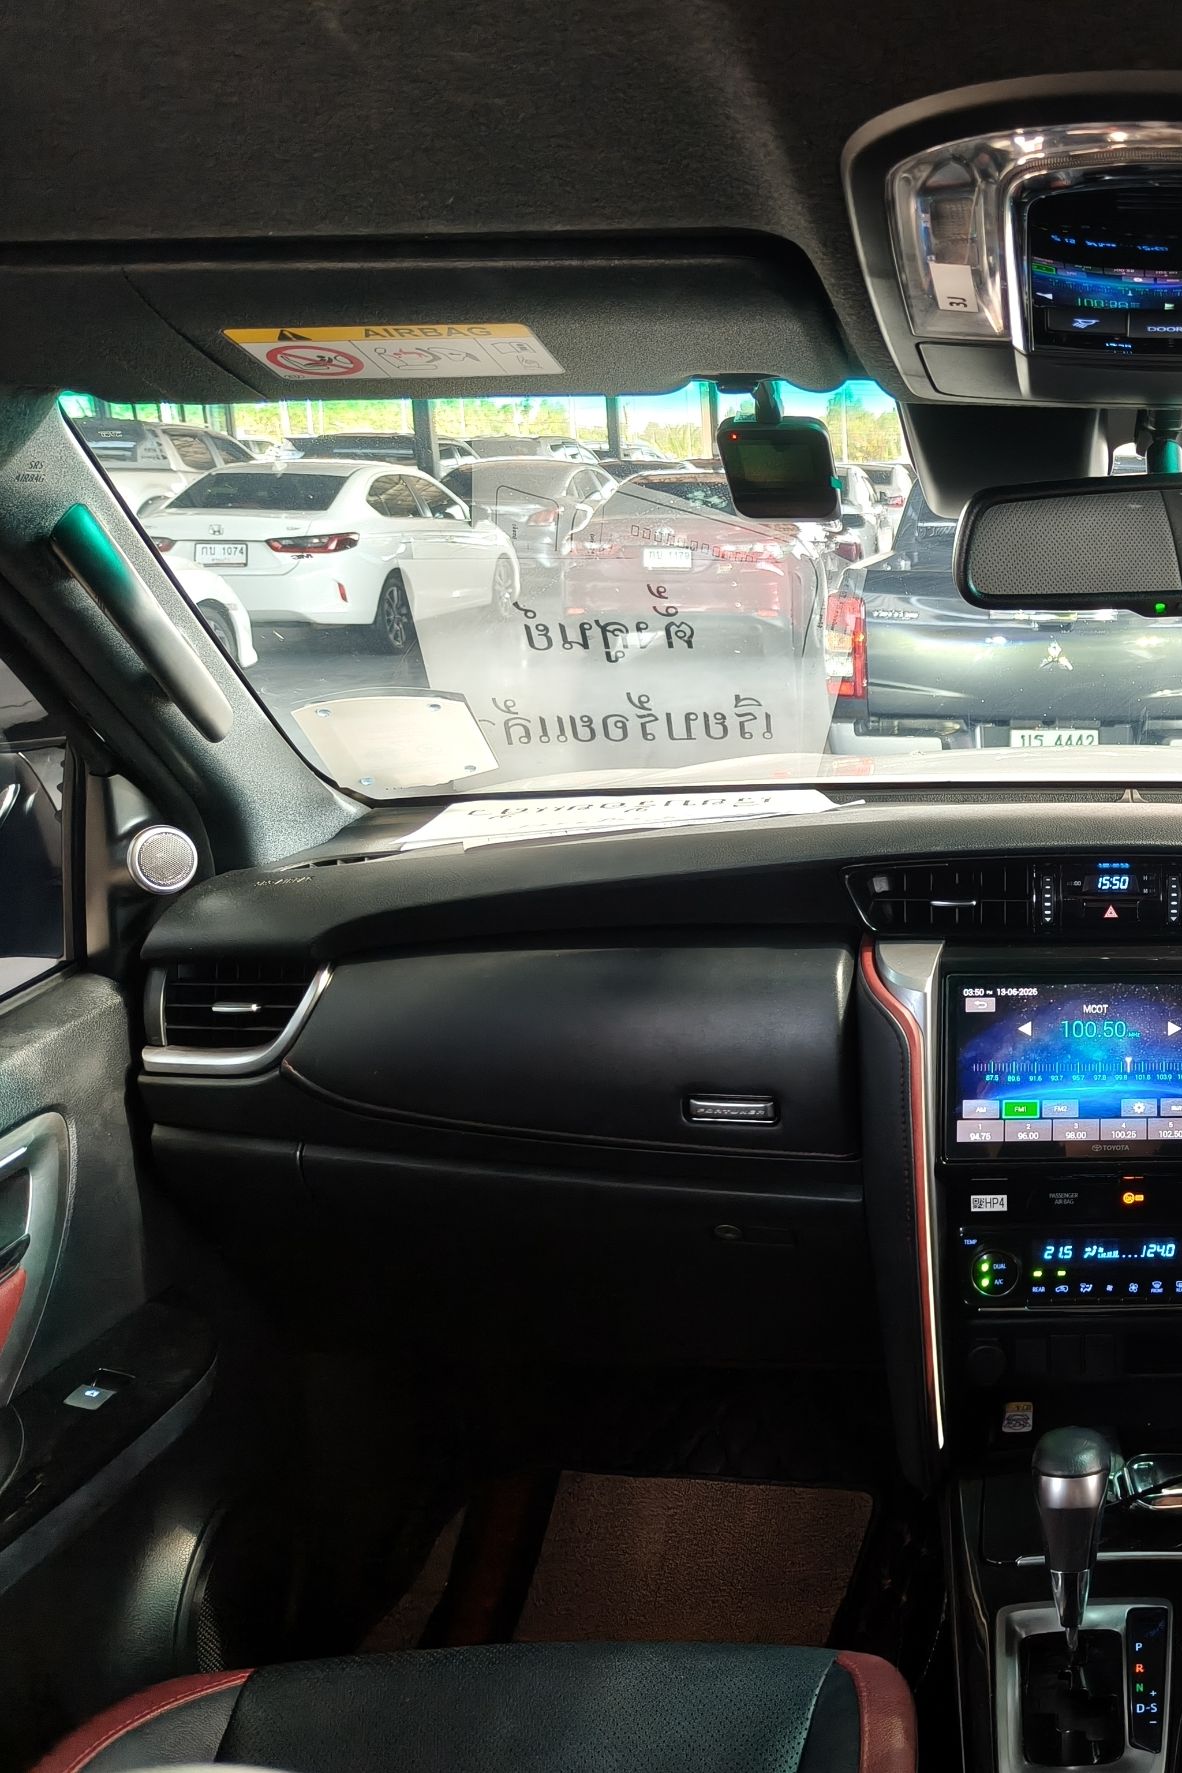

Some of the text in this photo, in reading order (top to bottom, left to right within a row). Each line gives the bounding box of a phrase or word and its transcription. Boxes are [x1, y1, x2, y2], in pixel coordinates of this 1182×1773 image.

[362, 326, 493, 339] AIRBAG
[222, 546, 244, 556] 1074
[1097, 876, 1129, 890] 15:50
[963, 988, 985, 997] 03:50
[1083, 1004, 1109, 1014] MCOT
[1061, 1020, 1126, 1038] 100.50
[1017, 1131, 1039, 1140] 96.00
[1111, 1130, 1137, 1139] 100.25
[985, 1197, 1005, 1209] HP4
[1135, 1643, 1142, 1651] P
[1136, 1664, 1144, 1673] R
[1136, 1684, 1144, 1692] N
